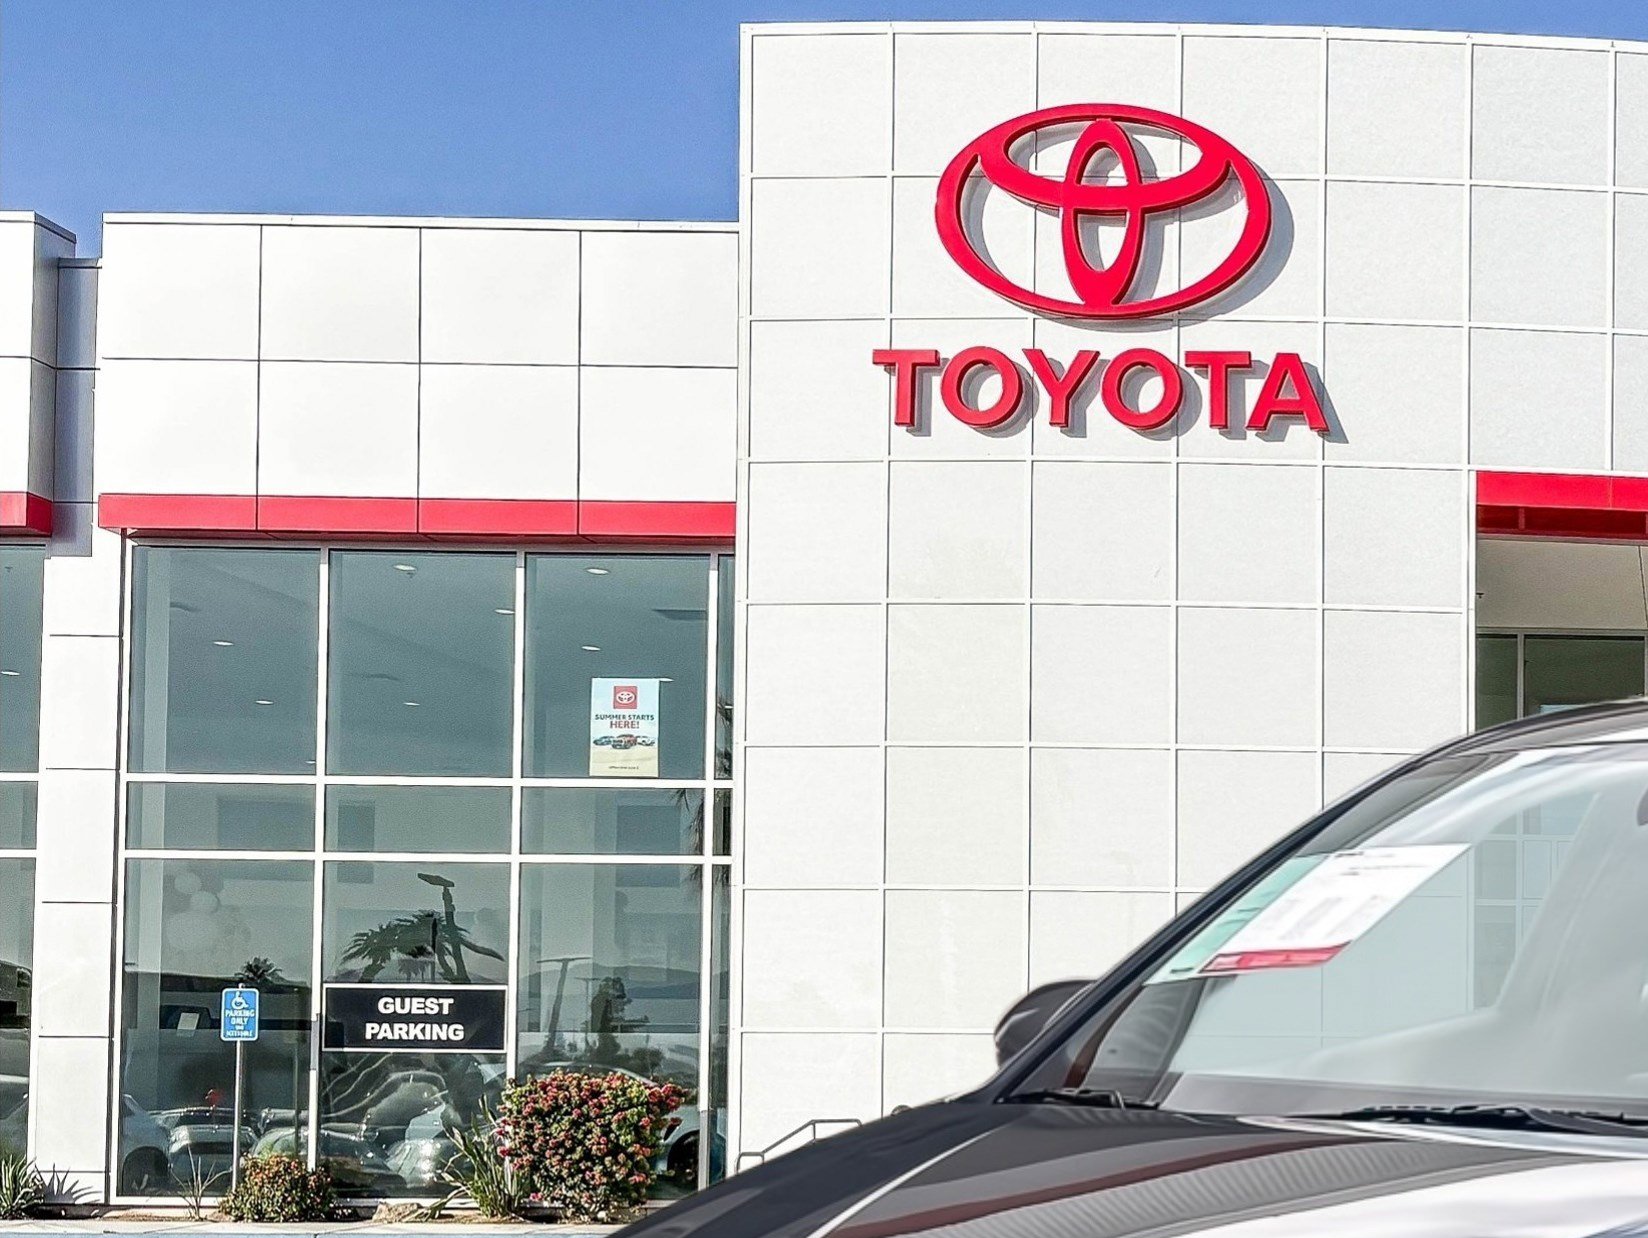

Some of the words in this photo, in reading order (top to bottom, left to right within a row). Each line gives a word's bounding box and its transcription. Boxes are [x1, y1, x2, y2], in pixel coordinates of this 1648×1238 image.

[873, 346, 1330, 433] TOYOTA
[609, 721, 640, 729] HERE!
[377, 997, 454, 1015] GUEST
[365, 1022, 465, 1041] PARKING
